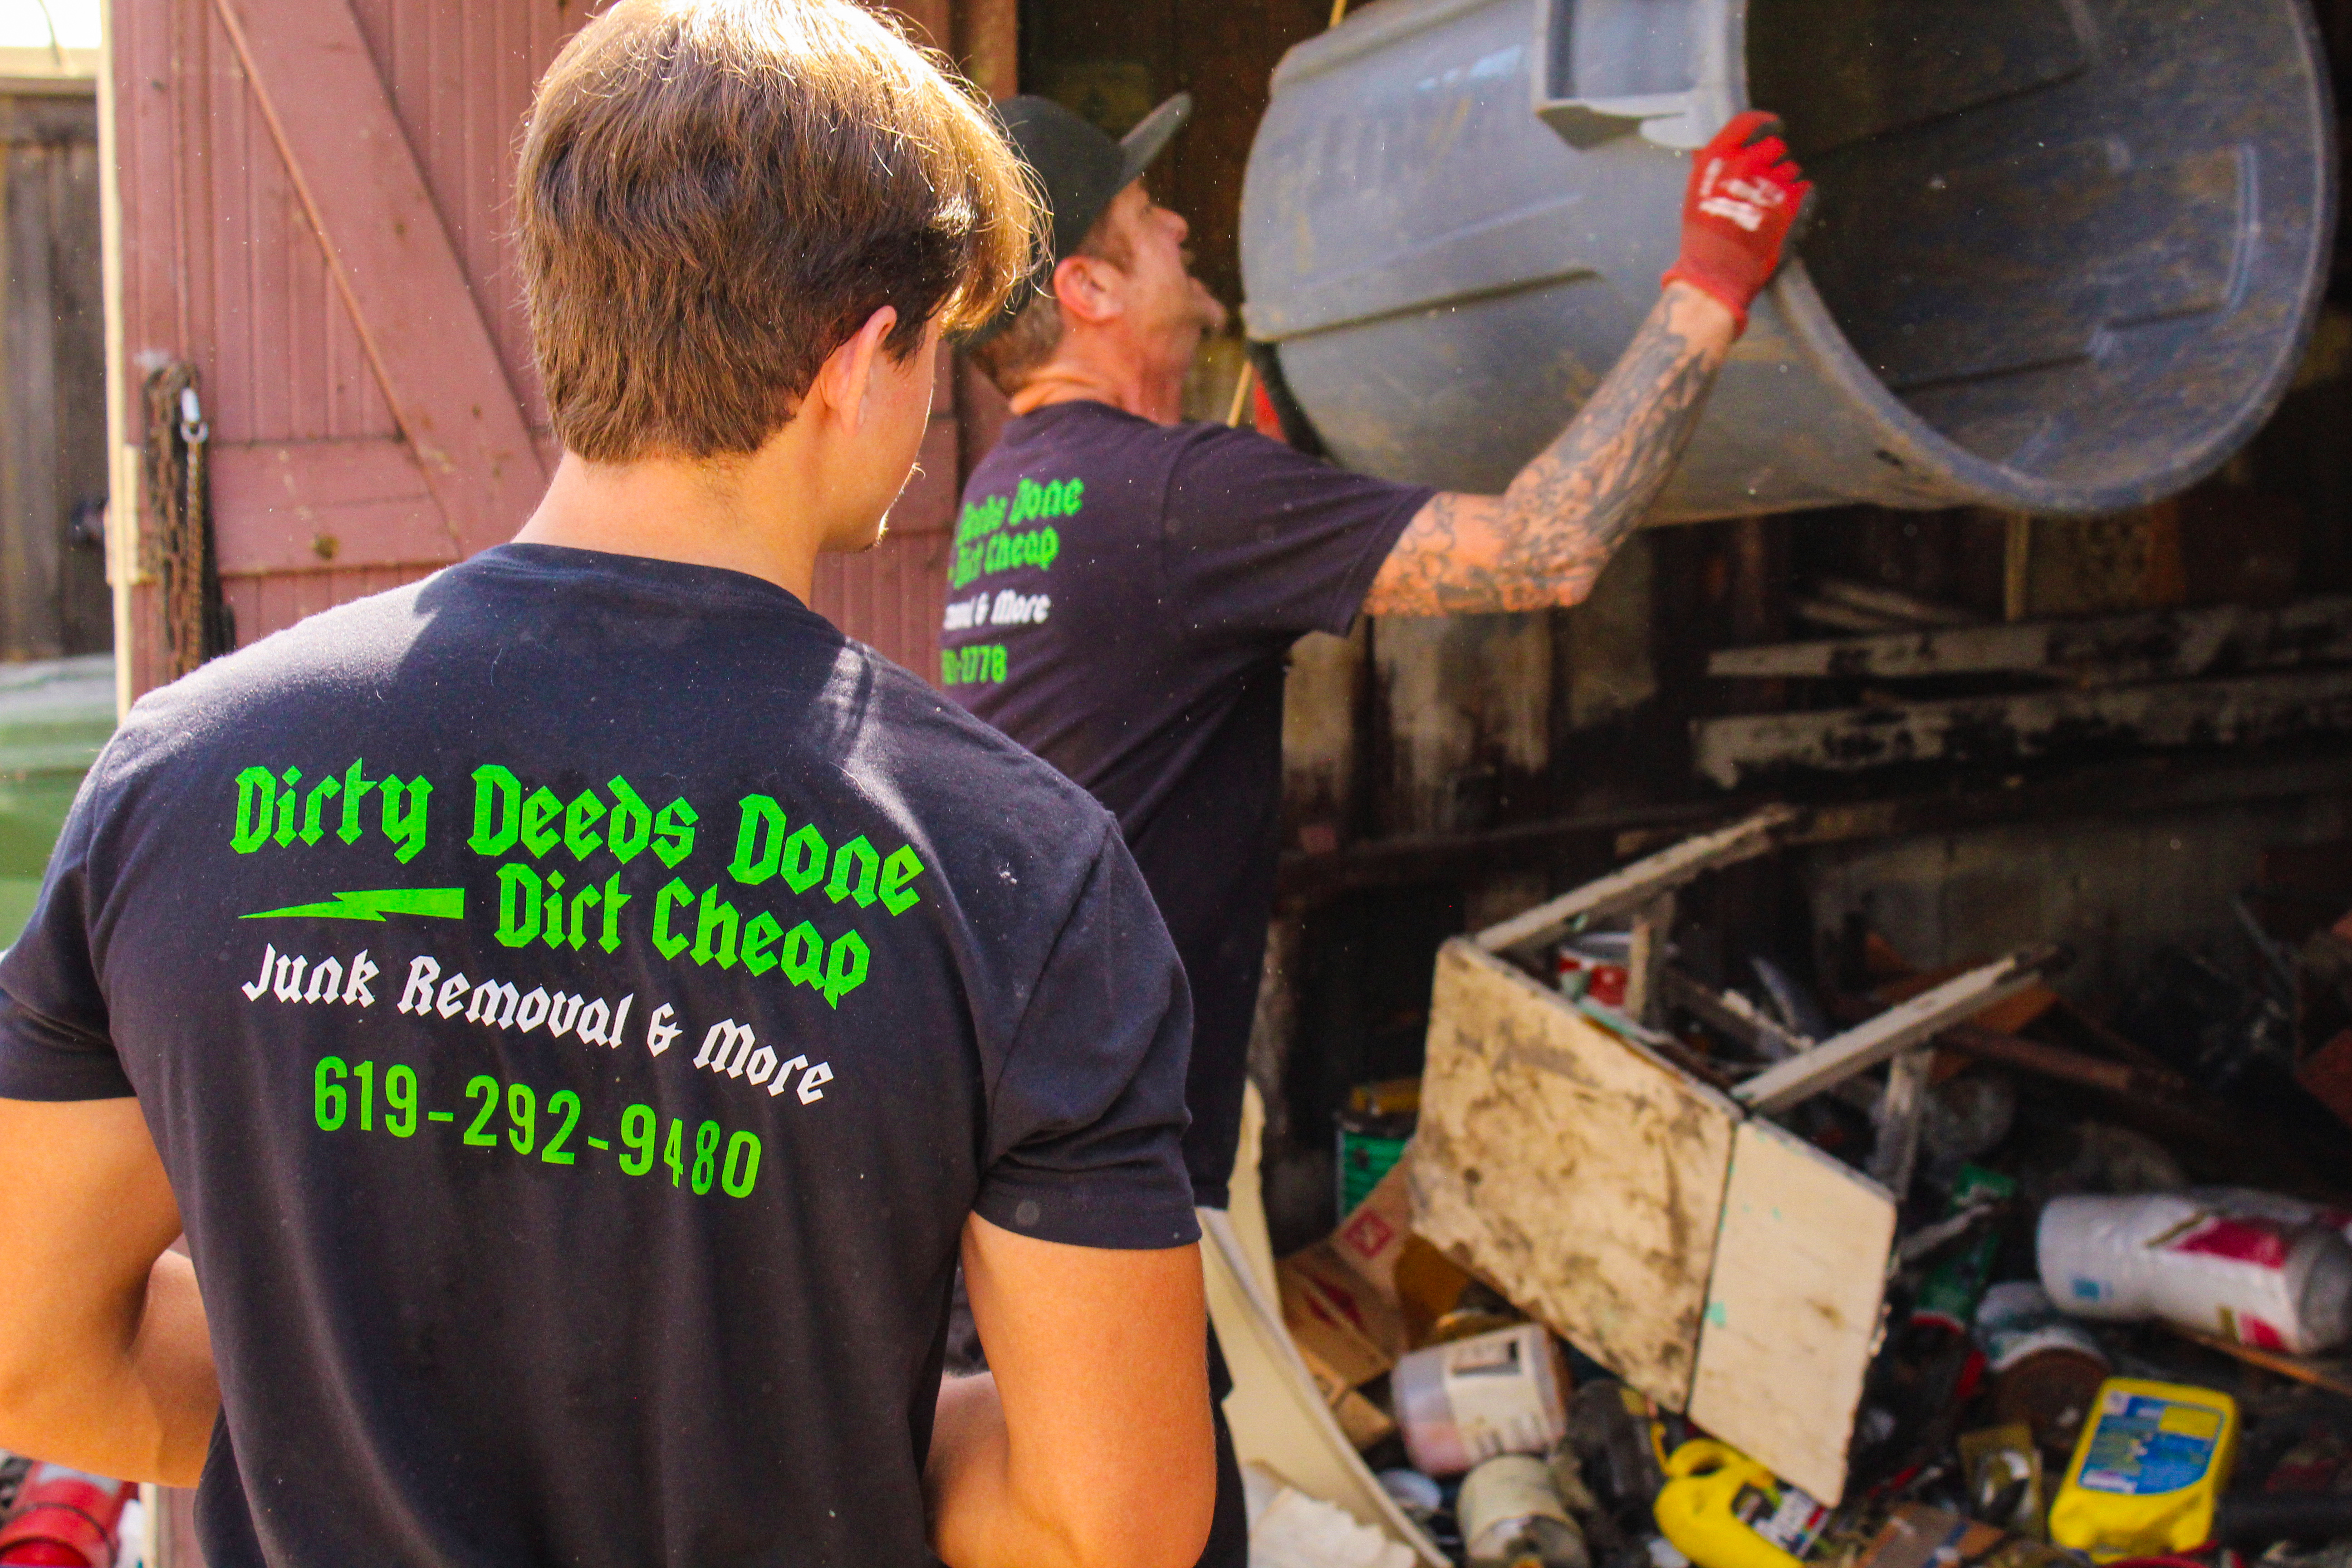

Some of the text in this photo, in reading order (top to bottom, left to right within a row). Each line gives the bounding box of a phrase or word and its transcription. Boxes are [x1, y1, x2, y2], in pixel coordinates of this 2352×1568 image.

[990, 588, 1052, 625] More
[230, 758, 925, 916] Dirty Deeds Done
[494, 863, 871, 1009] Dirt Cheap
[242, 943, 833, 1104] Junk Removal & More
[315, 1056, 761, 1198] 619-292-9480
